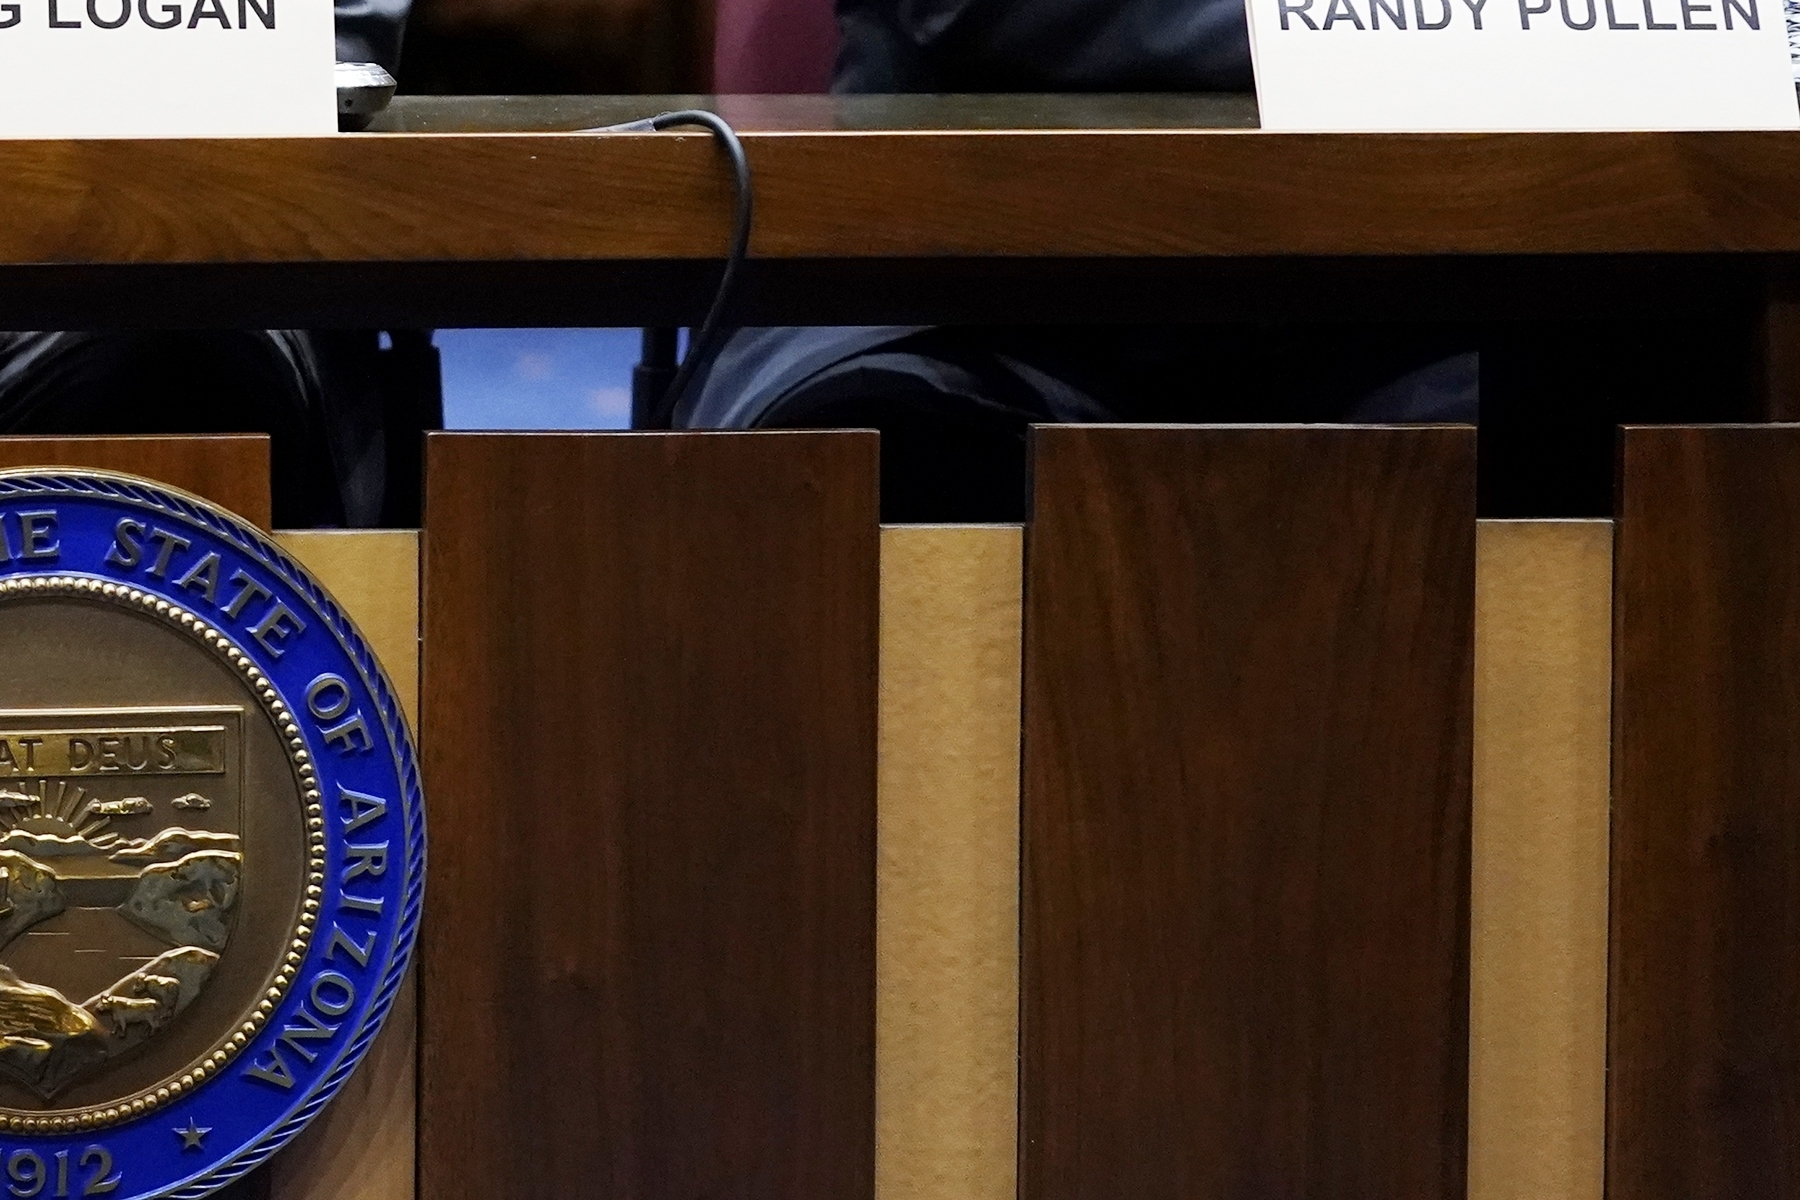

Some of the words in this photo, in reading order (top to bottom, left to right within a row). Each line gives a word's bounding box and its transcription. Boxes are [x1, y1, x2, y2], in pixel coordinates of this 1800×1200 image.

[105, 517, 307, 659] STATE
[68, 733, 178, 771] DEUS
[305, 671, 374, 760] OF
[245, 782, 390, 1089] ARIZONA
